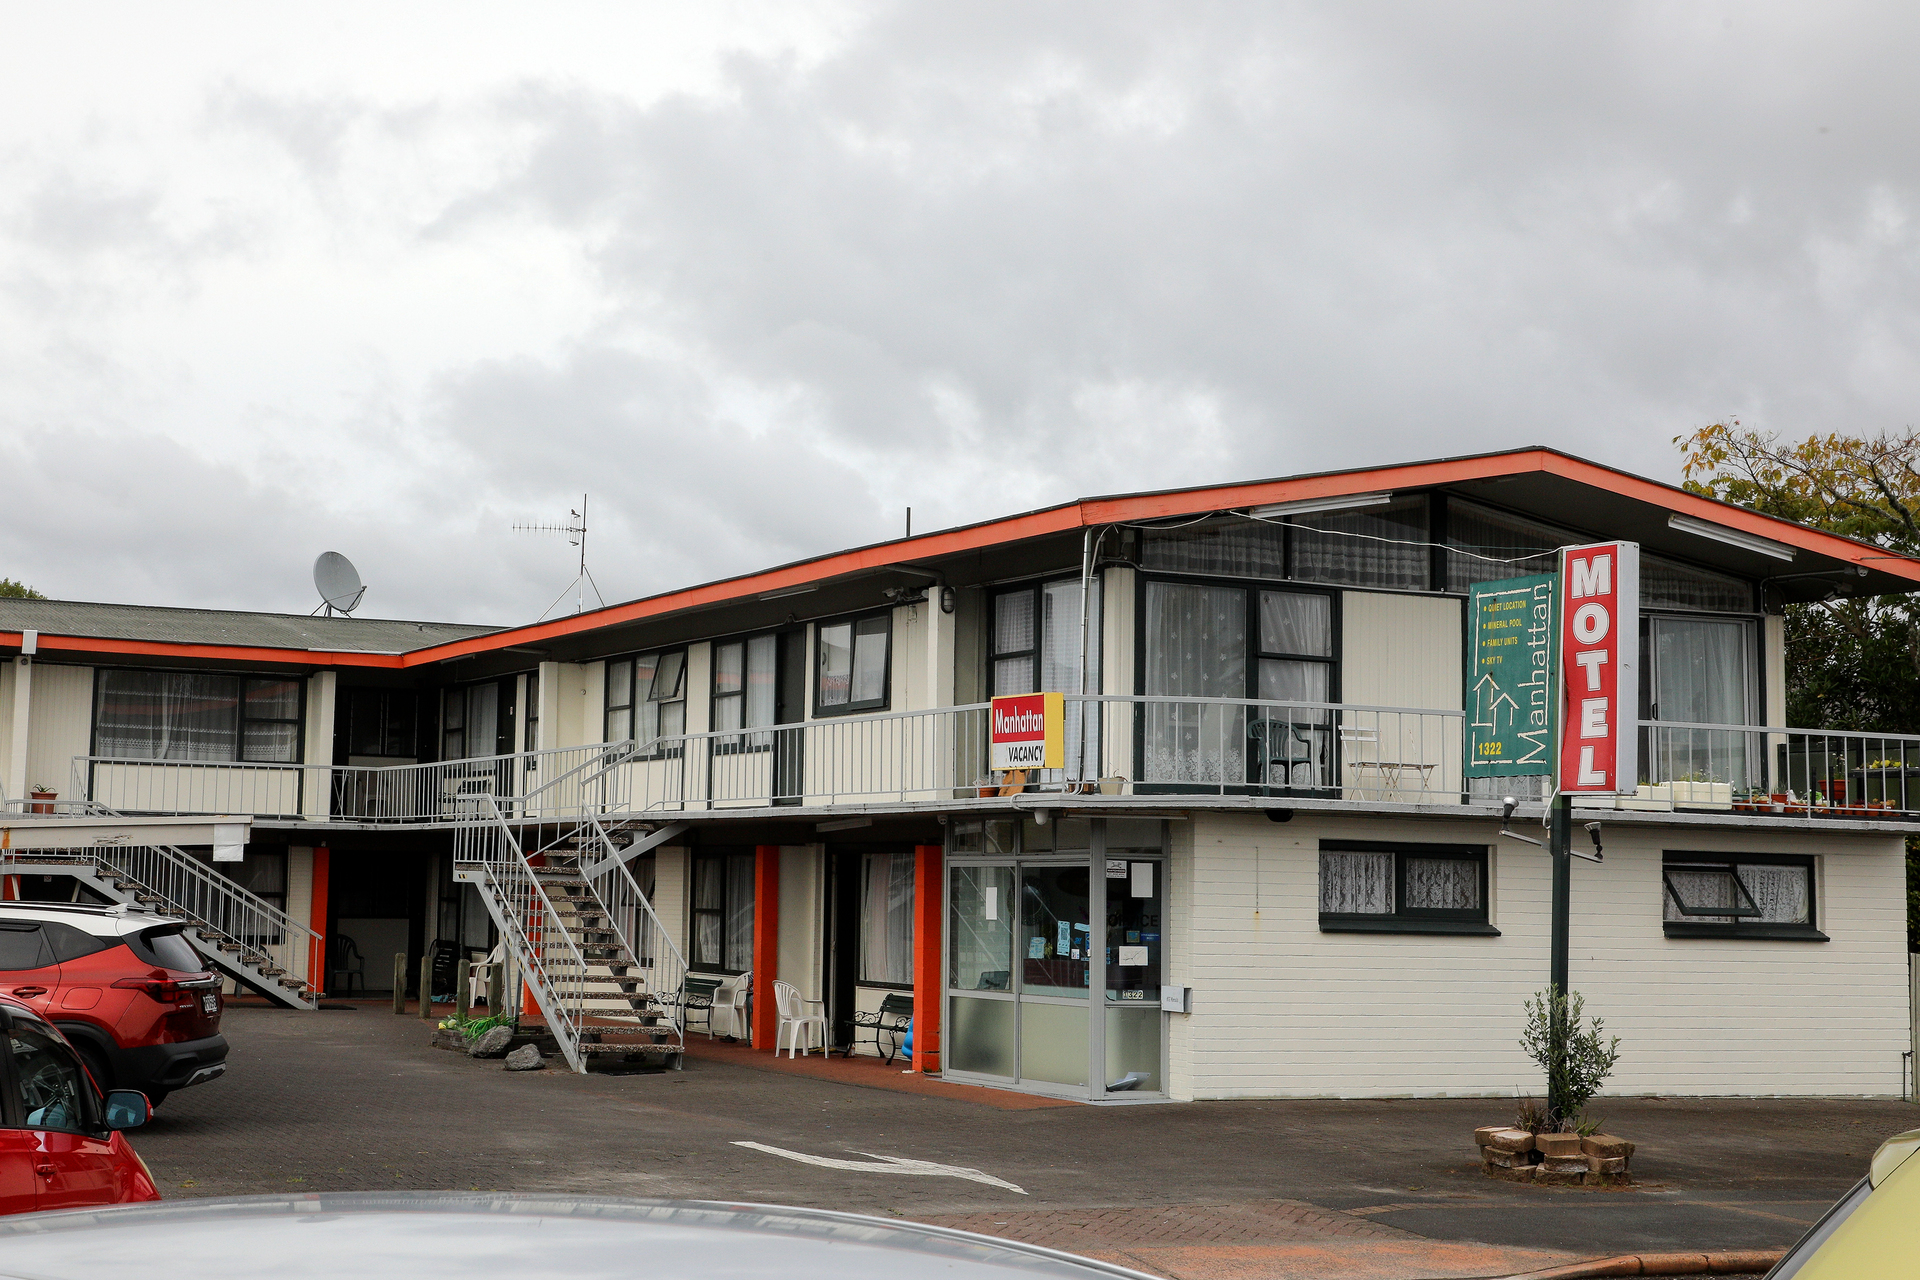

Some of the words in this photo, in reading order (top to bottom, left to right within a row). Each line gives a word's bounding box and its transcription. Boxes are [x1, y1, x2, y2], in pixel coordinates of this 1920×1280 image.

[1488, 603, 1502, 612] QUIET
[1503, 600, 1527, 611] LOCATION
[1487, 620, 1508, 630] MINERAL
[1509, 618, 1522, 628] POOL
[1487, 637, 1503, 647] FAMILY
[1504, 636, 1518, 646] UNITS
[1486, 656, 1496, 665] SKY
[1496, 655, 1503, 664] TV
[1516, 583, 1549, 765] Manhattan
[1571, 554, 1612, 786] MOTEL
[994, 705, 1044, 734] Manhattan
[1008, 745, 1044, 762] VACANCY
[1478, 742, 1502, 756] 1322
[1109, 914, 1158, 927] OFICE
[1123, 990, 1143, 998] 1322
